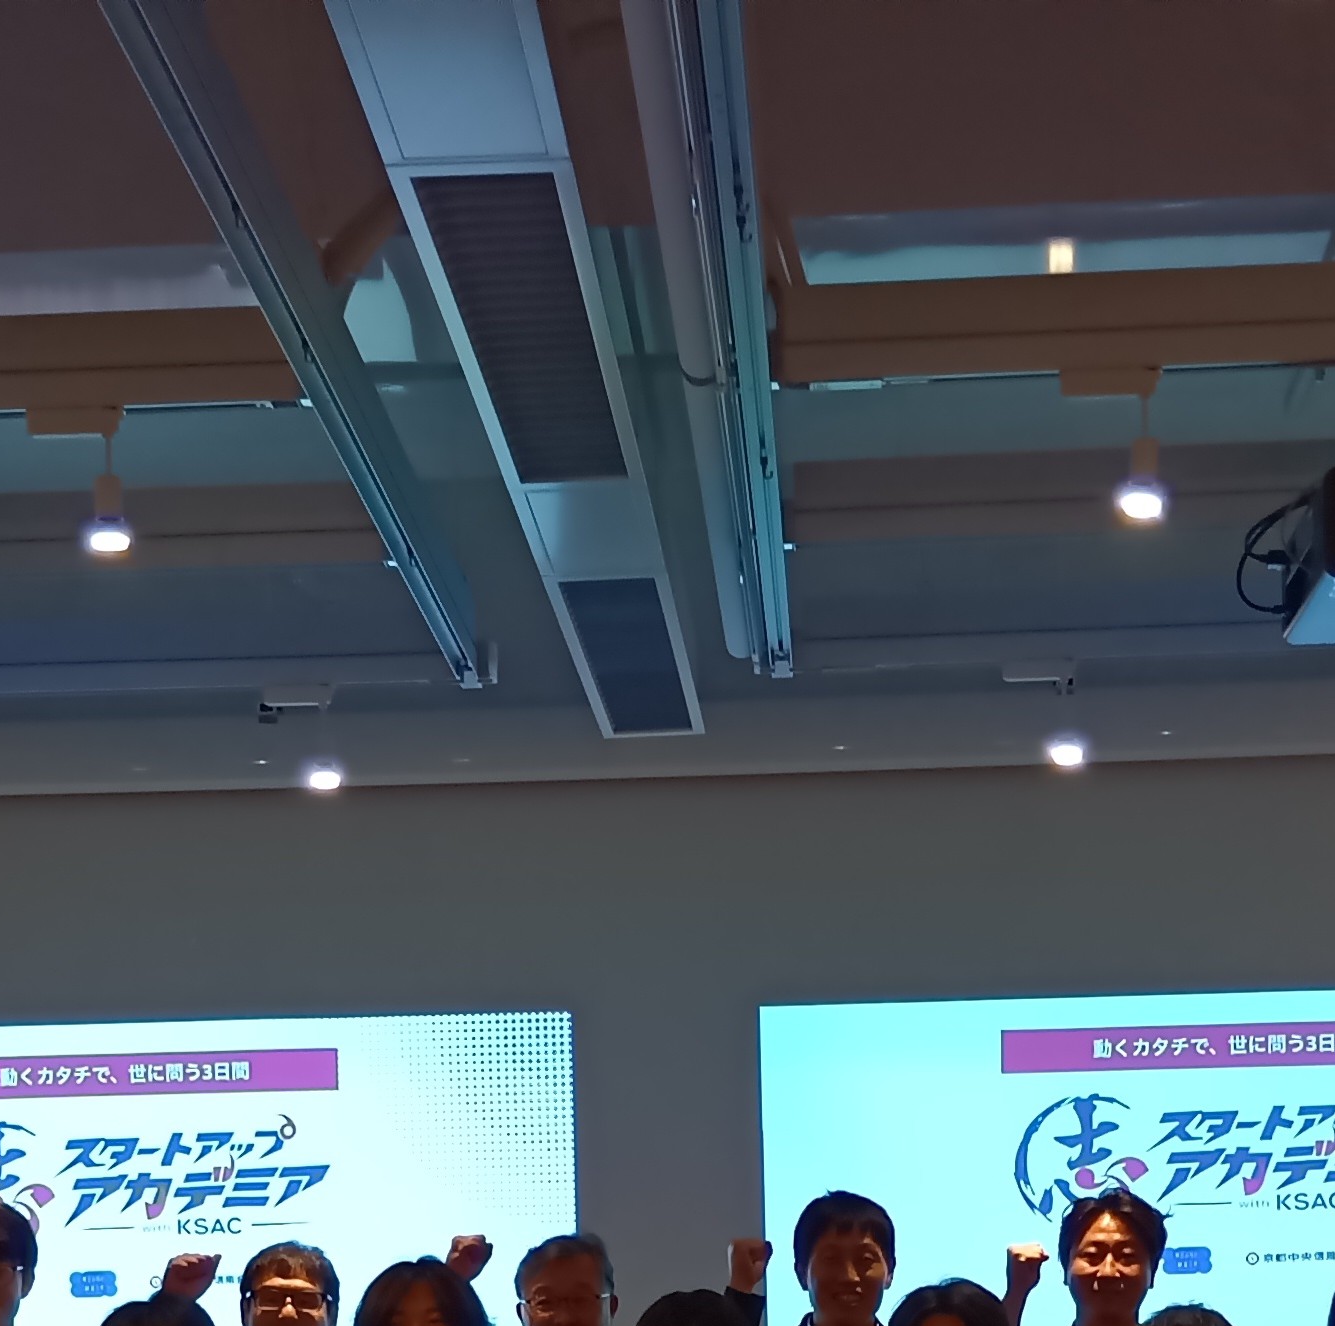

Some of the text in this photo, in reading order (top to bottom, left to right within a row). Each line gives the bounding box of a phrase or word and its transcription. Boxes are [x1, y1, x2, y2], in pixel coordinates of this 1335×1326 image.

[54, 1114, 296, 1177] スタートアップ
[64, 1164, 331, 1228] アカデミア
[177, 1217, 242, 1235] KSAC
